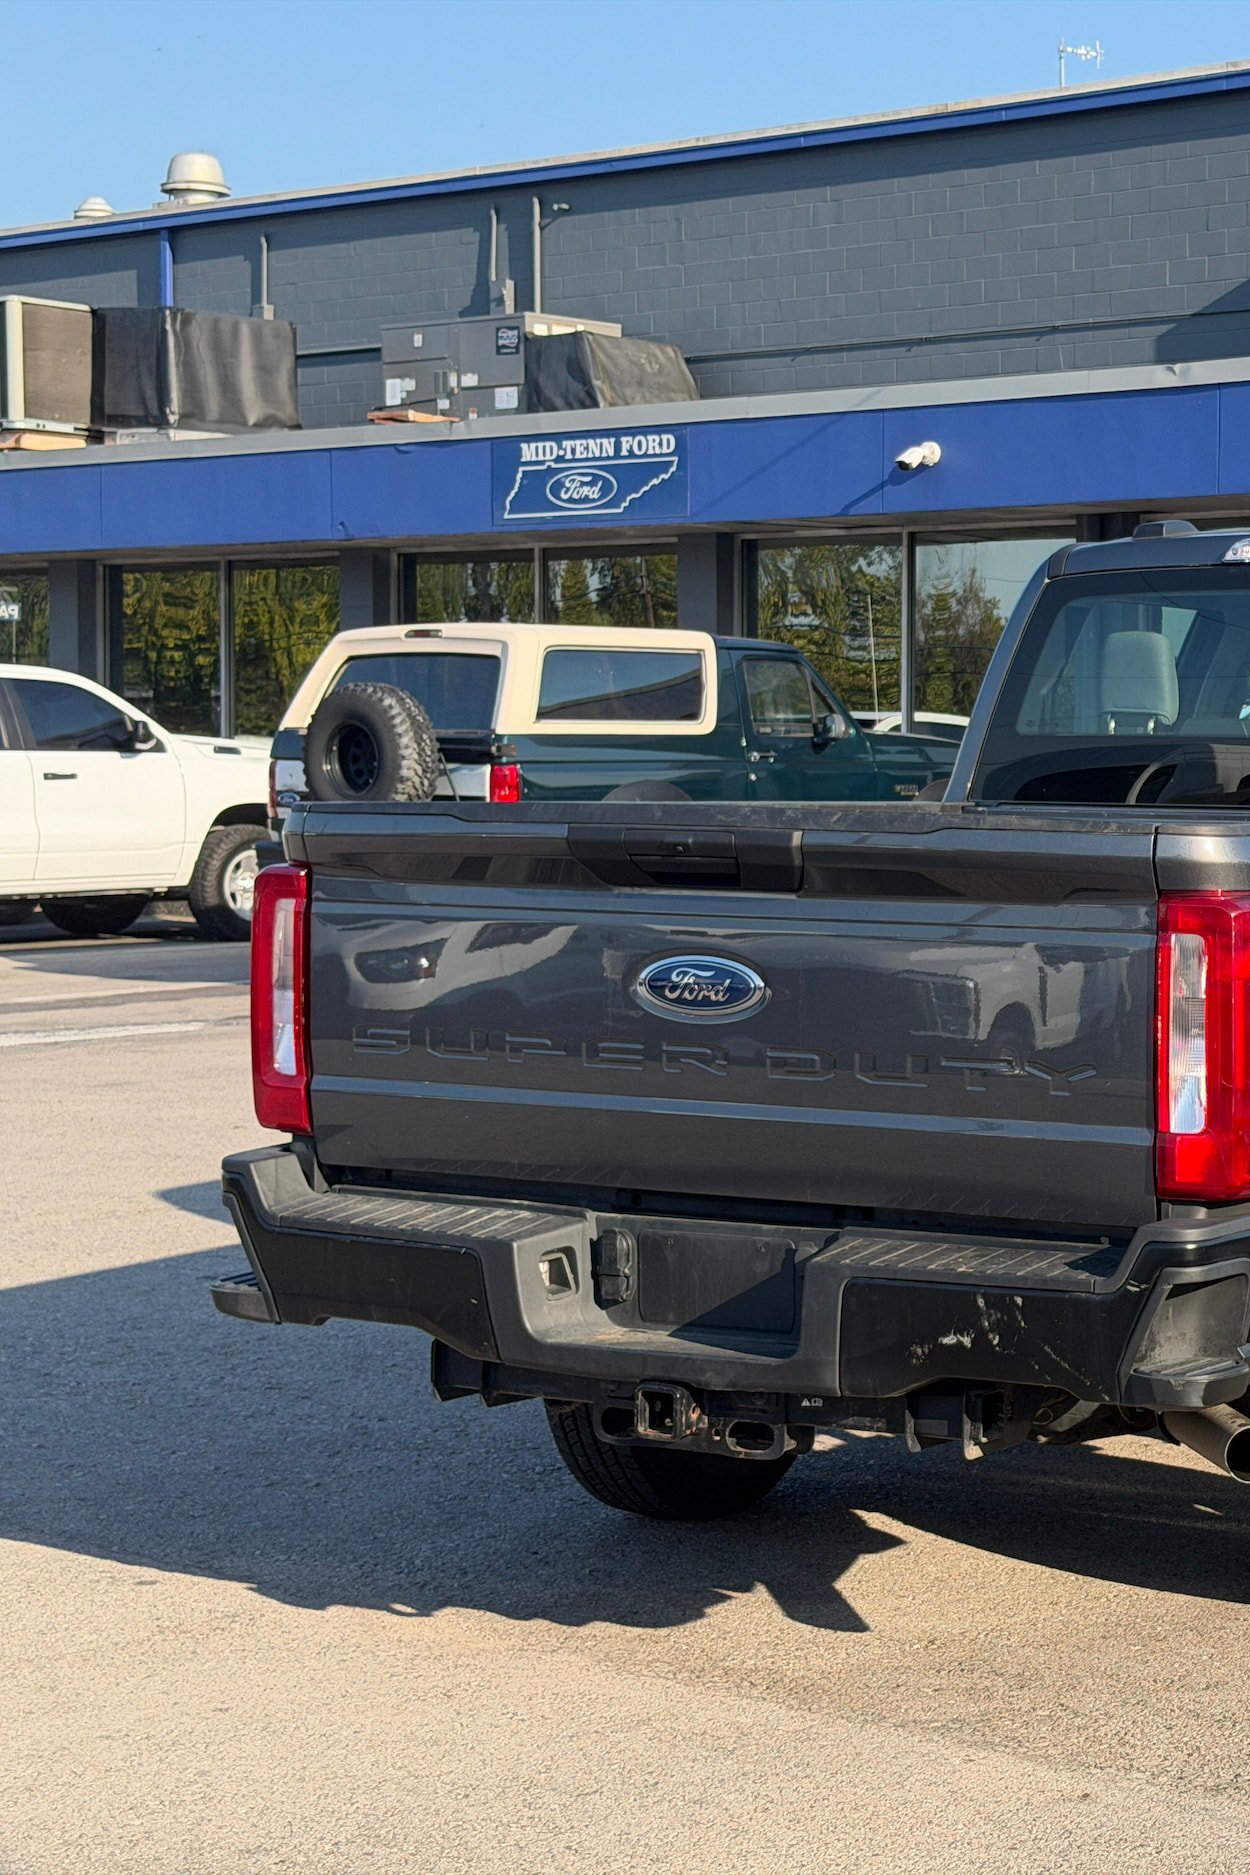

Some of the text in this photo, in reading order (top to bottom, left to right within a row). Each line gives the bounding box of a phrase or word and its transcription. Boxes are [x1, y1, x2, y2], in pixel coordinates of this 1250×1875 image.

[620, 433, 676, 456] FORD
[560, 474, 603, 500] Ford
[664, 967, 732, 1002] Ford
[352, 1023, 1098, 1097] SUPER DUTY
